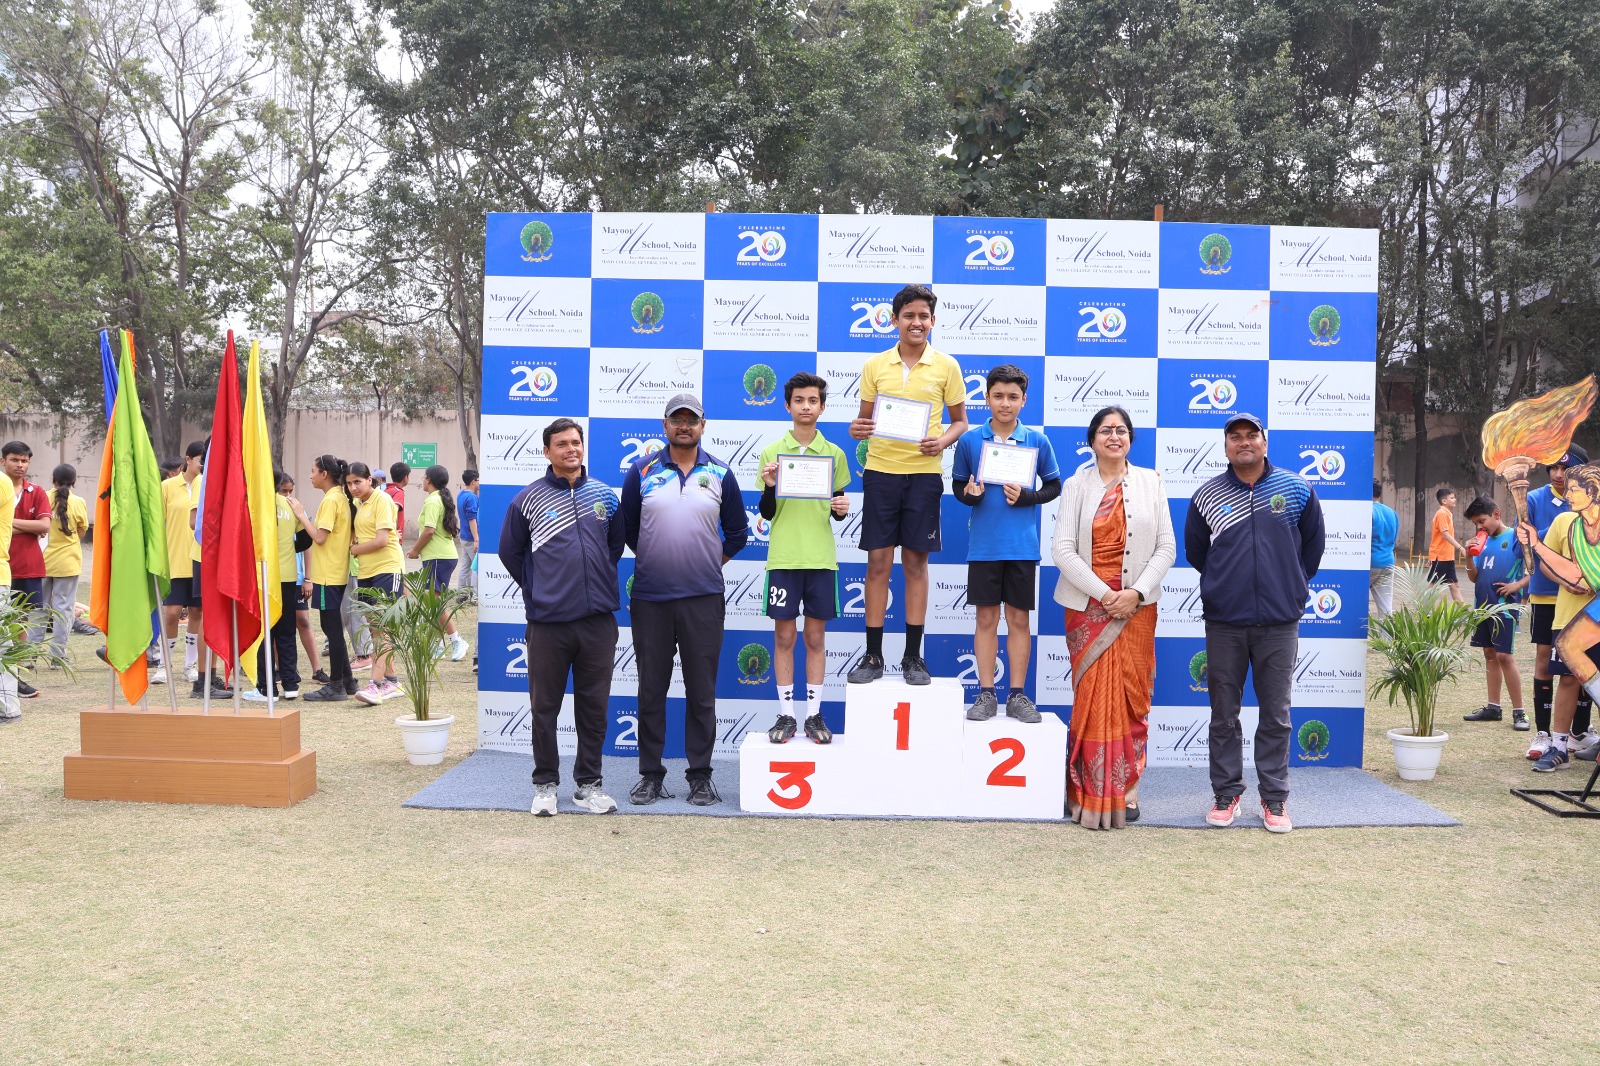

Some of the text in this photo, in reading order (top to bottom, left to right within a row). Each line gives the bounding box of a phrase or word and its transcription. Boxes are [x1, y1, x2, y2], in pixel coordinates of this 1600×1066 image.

[602, 226, 633, 236] Mayoor
[828, 229, 860, 240] Mayoor
[1055, 234, 1088, 244] Mayoor
[1280, 238, 1310, 249] Mayoor
[641, 240, 697, 249] School, Noida
[736, 230, 787, 262] 20
[869, 244, 925, 253] School, Noida
[964, 234, 1015, 266] 20
[1096, 249, 1152, 258] School, Noida
[1318, 253, 1371, 262] School, Noida
[490, 293, 520, 303] Mayoor
[713, 297, 745, 307] Mayoor
[941, 301, 973, 311] Mayoor
[1167, 306, 1199, 316] Mayoor
[528, 308, 582, 316] School, Noida
[753, 312, 810, 321] School, Noida
[849, 301, 895, 334] 20
[982, 316, 1038, 325] School, Noida
[1077, 306, 1127, 338] 20
[1207, 320, 1262, 329] School, Noida
[599, 365, 631, 375] Mayoor
[826, 369, 858, 379] Mayoor
[509, 365, 558, 397] 20
[639, 379, 694, 388] School, Noida
[1054, 373, 1086, 384] Mayoor
[1278, 377, 1309, 387] Mayoor
[1094, 388, 1150, 397] School, Noida
[1188, 377, 1237, 410] 20
[1316, 392, 1369, 400] School, Noida
[487, 432, 517, 442] Mayoor
[710, 437, 742, 447] Mayoor
[525, 447, 544, 455] Scho
[1165, 445, 1197, 455] Mayoor
[1204, 460, 1228, 468] Schoo
[1297, 449, 1345, 481] 20
[1343, 531, 1366, 539] Noida
[1483, 555, 1495, 569] 14
[485, 571, 512, 581] Mayoo
[1161, 584, 1193, 594] Mayoor
[769, 586, 787, 607] 32
[505, 641, 528, 674] 2
[1046, 652, 1070, 663] Mayo
[1308, 669, 1361, 677] School, Noida
[484, 707, 514, 718] Mayoor
[615, 714, 638, 746] 2
[893, 702, 910, 750] 1
[1157, 723, 1188, 733] Mayoor
[986, 737, 1026, 787] 2
[767, 761, 816, 810] 3
